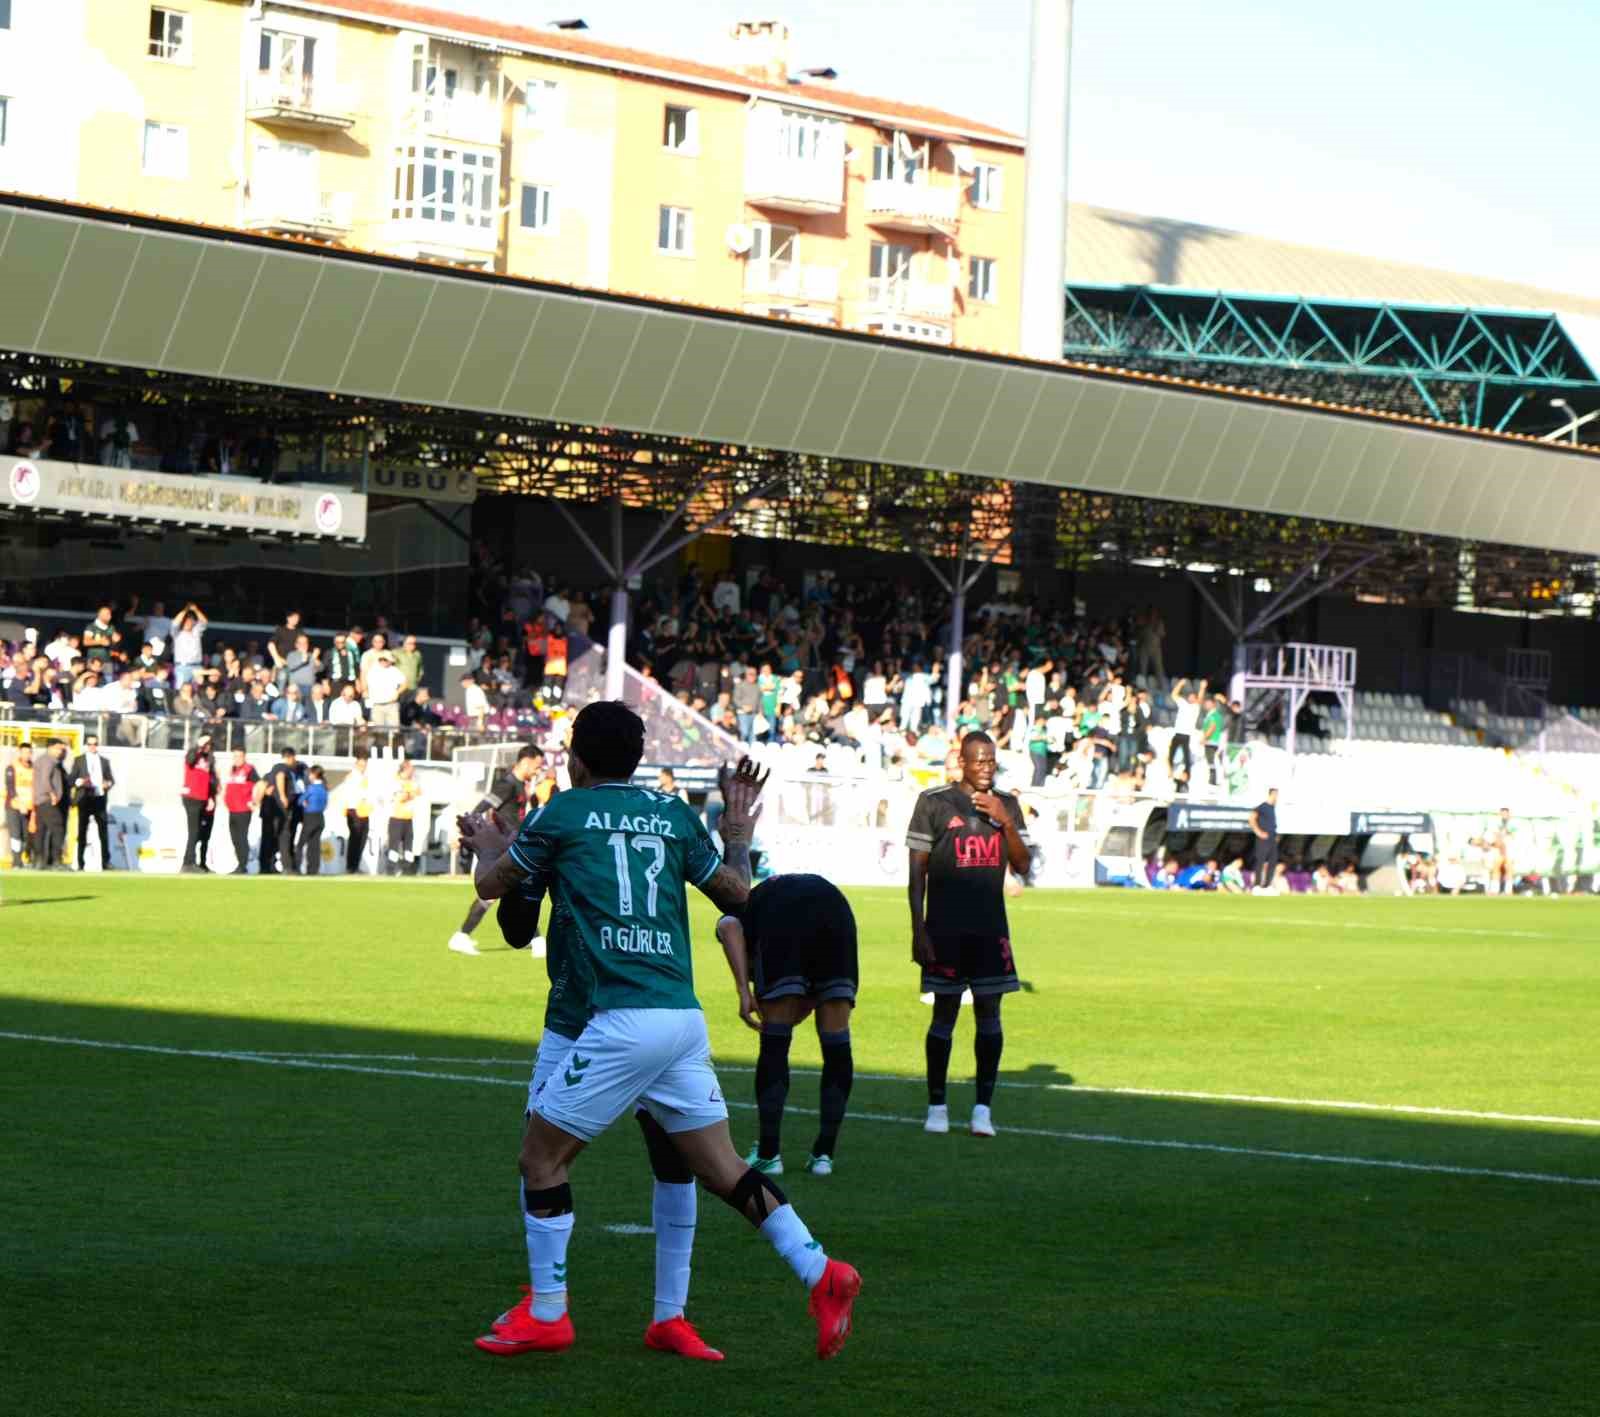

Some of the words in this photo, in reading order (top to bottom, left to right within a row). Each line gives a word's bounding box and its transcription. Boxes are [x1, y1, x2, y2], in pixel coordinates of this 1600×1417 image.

[584, 811, 677, 839] ALAGÖZ
[607, 832, 665, 917] 17
[617, 924, 674, 957] GÜRLER
